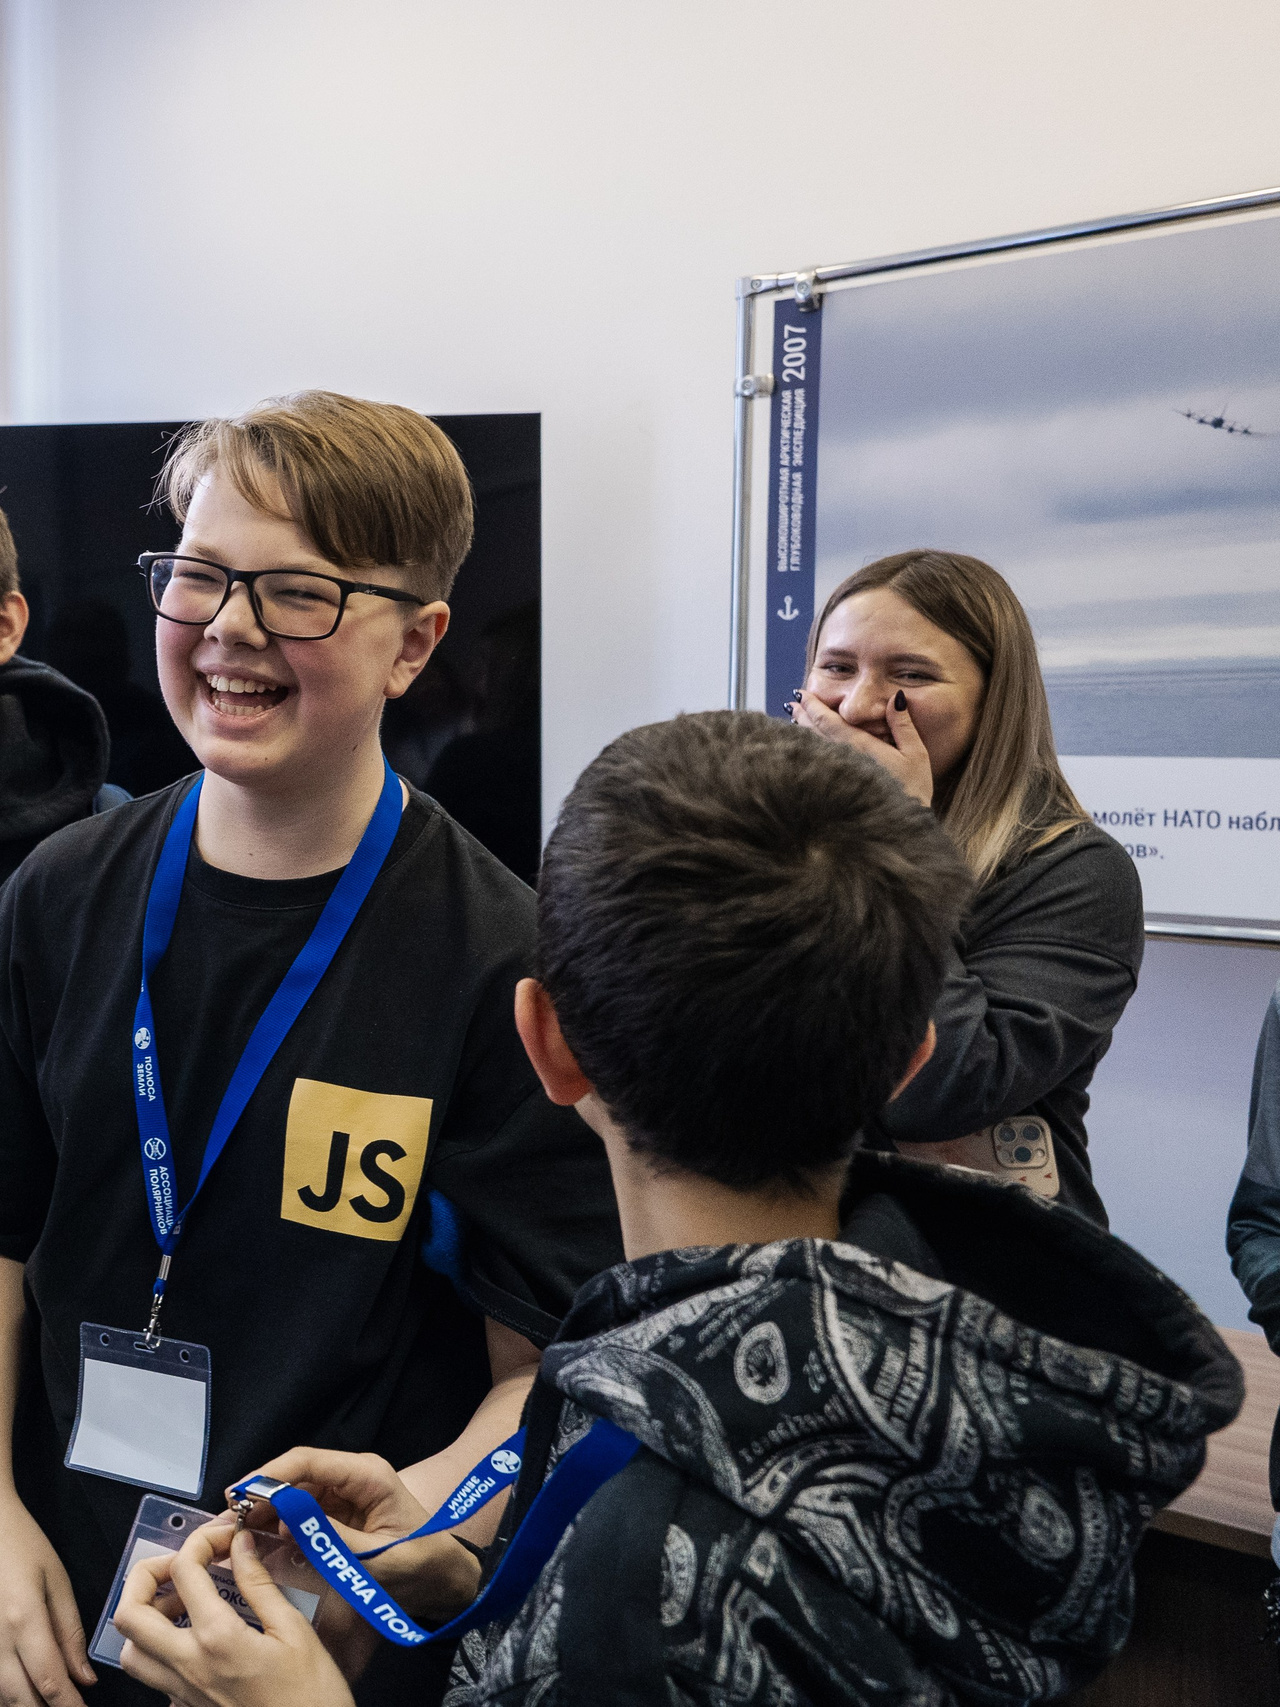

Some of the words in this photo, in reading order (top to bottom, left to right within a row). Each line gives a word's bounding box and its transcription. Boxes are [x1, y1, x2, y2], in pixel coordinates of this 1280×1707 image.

[782, 324, 807, 383] 2007
[780, 389, 792, 466] АРКТИЧЕСКАЯ
[792, 388, 806, 467] ЭКСПЕДИЦИЯ
[777, 467, 790, 572] ВЫСОКОШИРОТНАЯ
[790, 471, 803, 571] ГЛУБОКОВОДНАЯ
[1093, 807, 1156, 828] молёт
[1163, 809, 1222, 830] НАТО
[1228, 811, 1280, 831] набл
[1124, 843, 1165, 860] ов».
[136, 1063, 146, 1096] ЗЕМЛИ
[144, 1056, 156, 1102] ПОЛЮСА
[149, 1168, 167, 1235] ПОЛЯРНИКОВ
[297, 1130, 408, 1223] JS
[448, 1475, 480, 1511] ЗЕМЛИ
[450, 1476, 496, 1519] ПОЛЮСА
[300, 1516, 377, 1605] ВСТРЕЧА
[373, 1603, 425, 1642] ПОК
